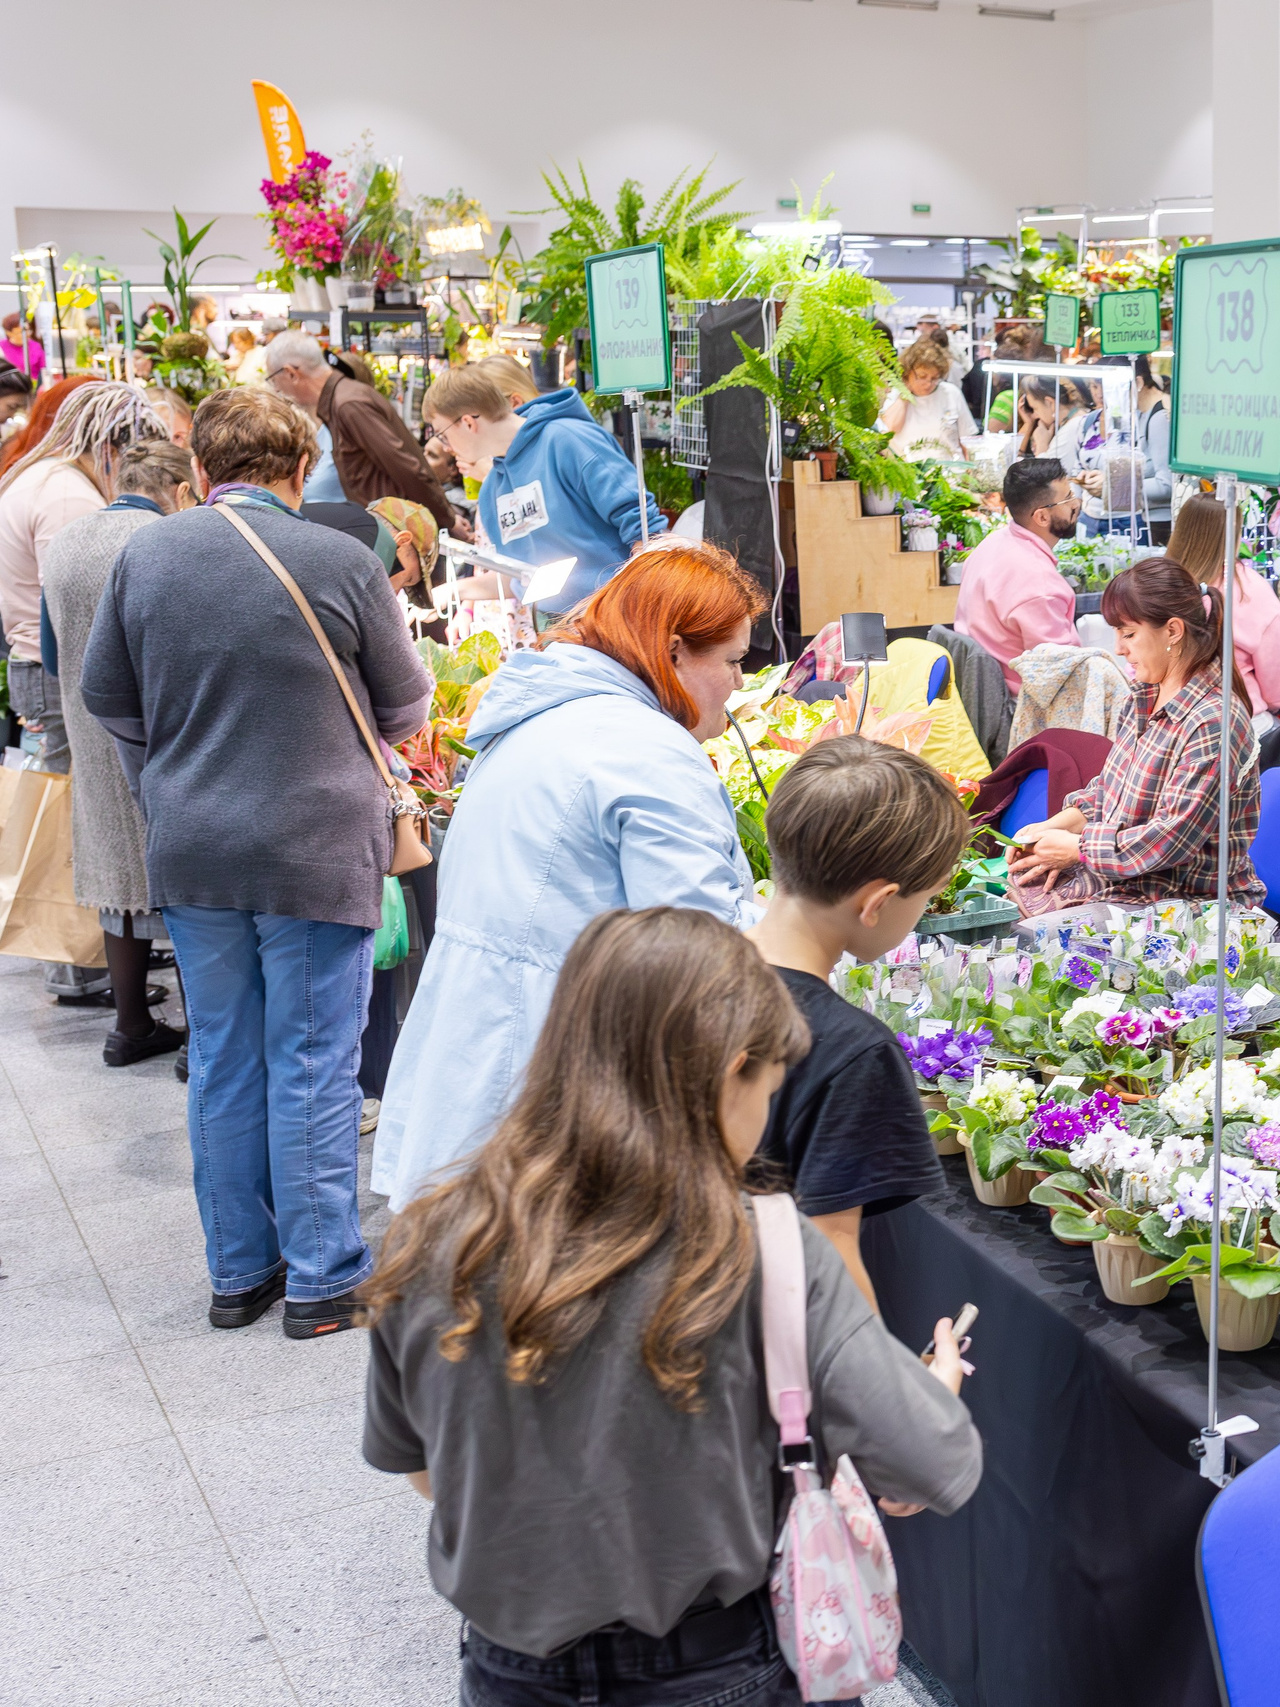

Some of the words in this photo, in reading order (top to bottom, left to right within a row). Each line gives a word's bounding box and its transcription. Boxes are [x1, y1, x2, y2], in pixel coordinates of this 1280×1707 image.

[615, 277, 640, 310] 139
[1121, 303, 1140, 318] 133
[1217, 289, 1255, 342] 138
[600, 337, 663, 360] ФЛОРАМАНИЯ
[1106, 330, 1157, 343] ТЕПЛИЧКА
[1182, 392, 1217, 416] ЕЛЕНА
[1201, 428, 1264, 458] ФИАЛКИ
